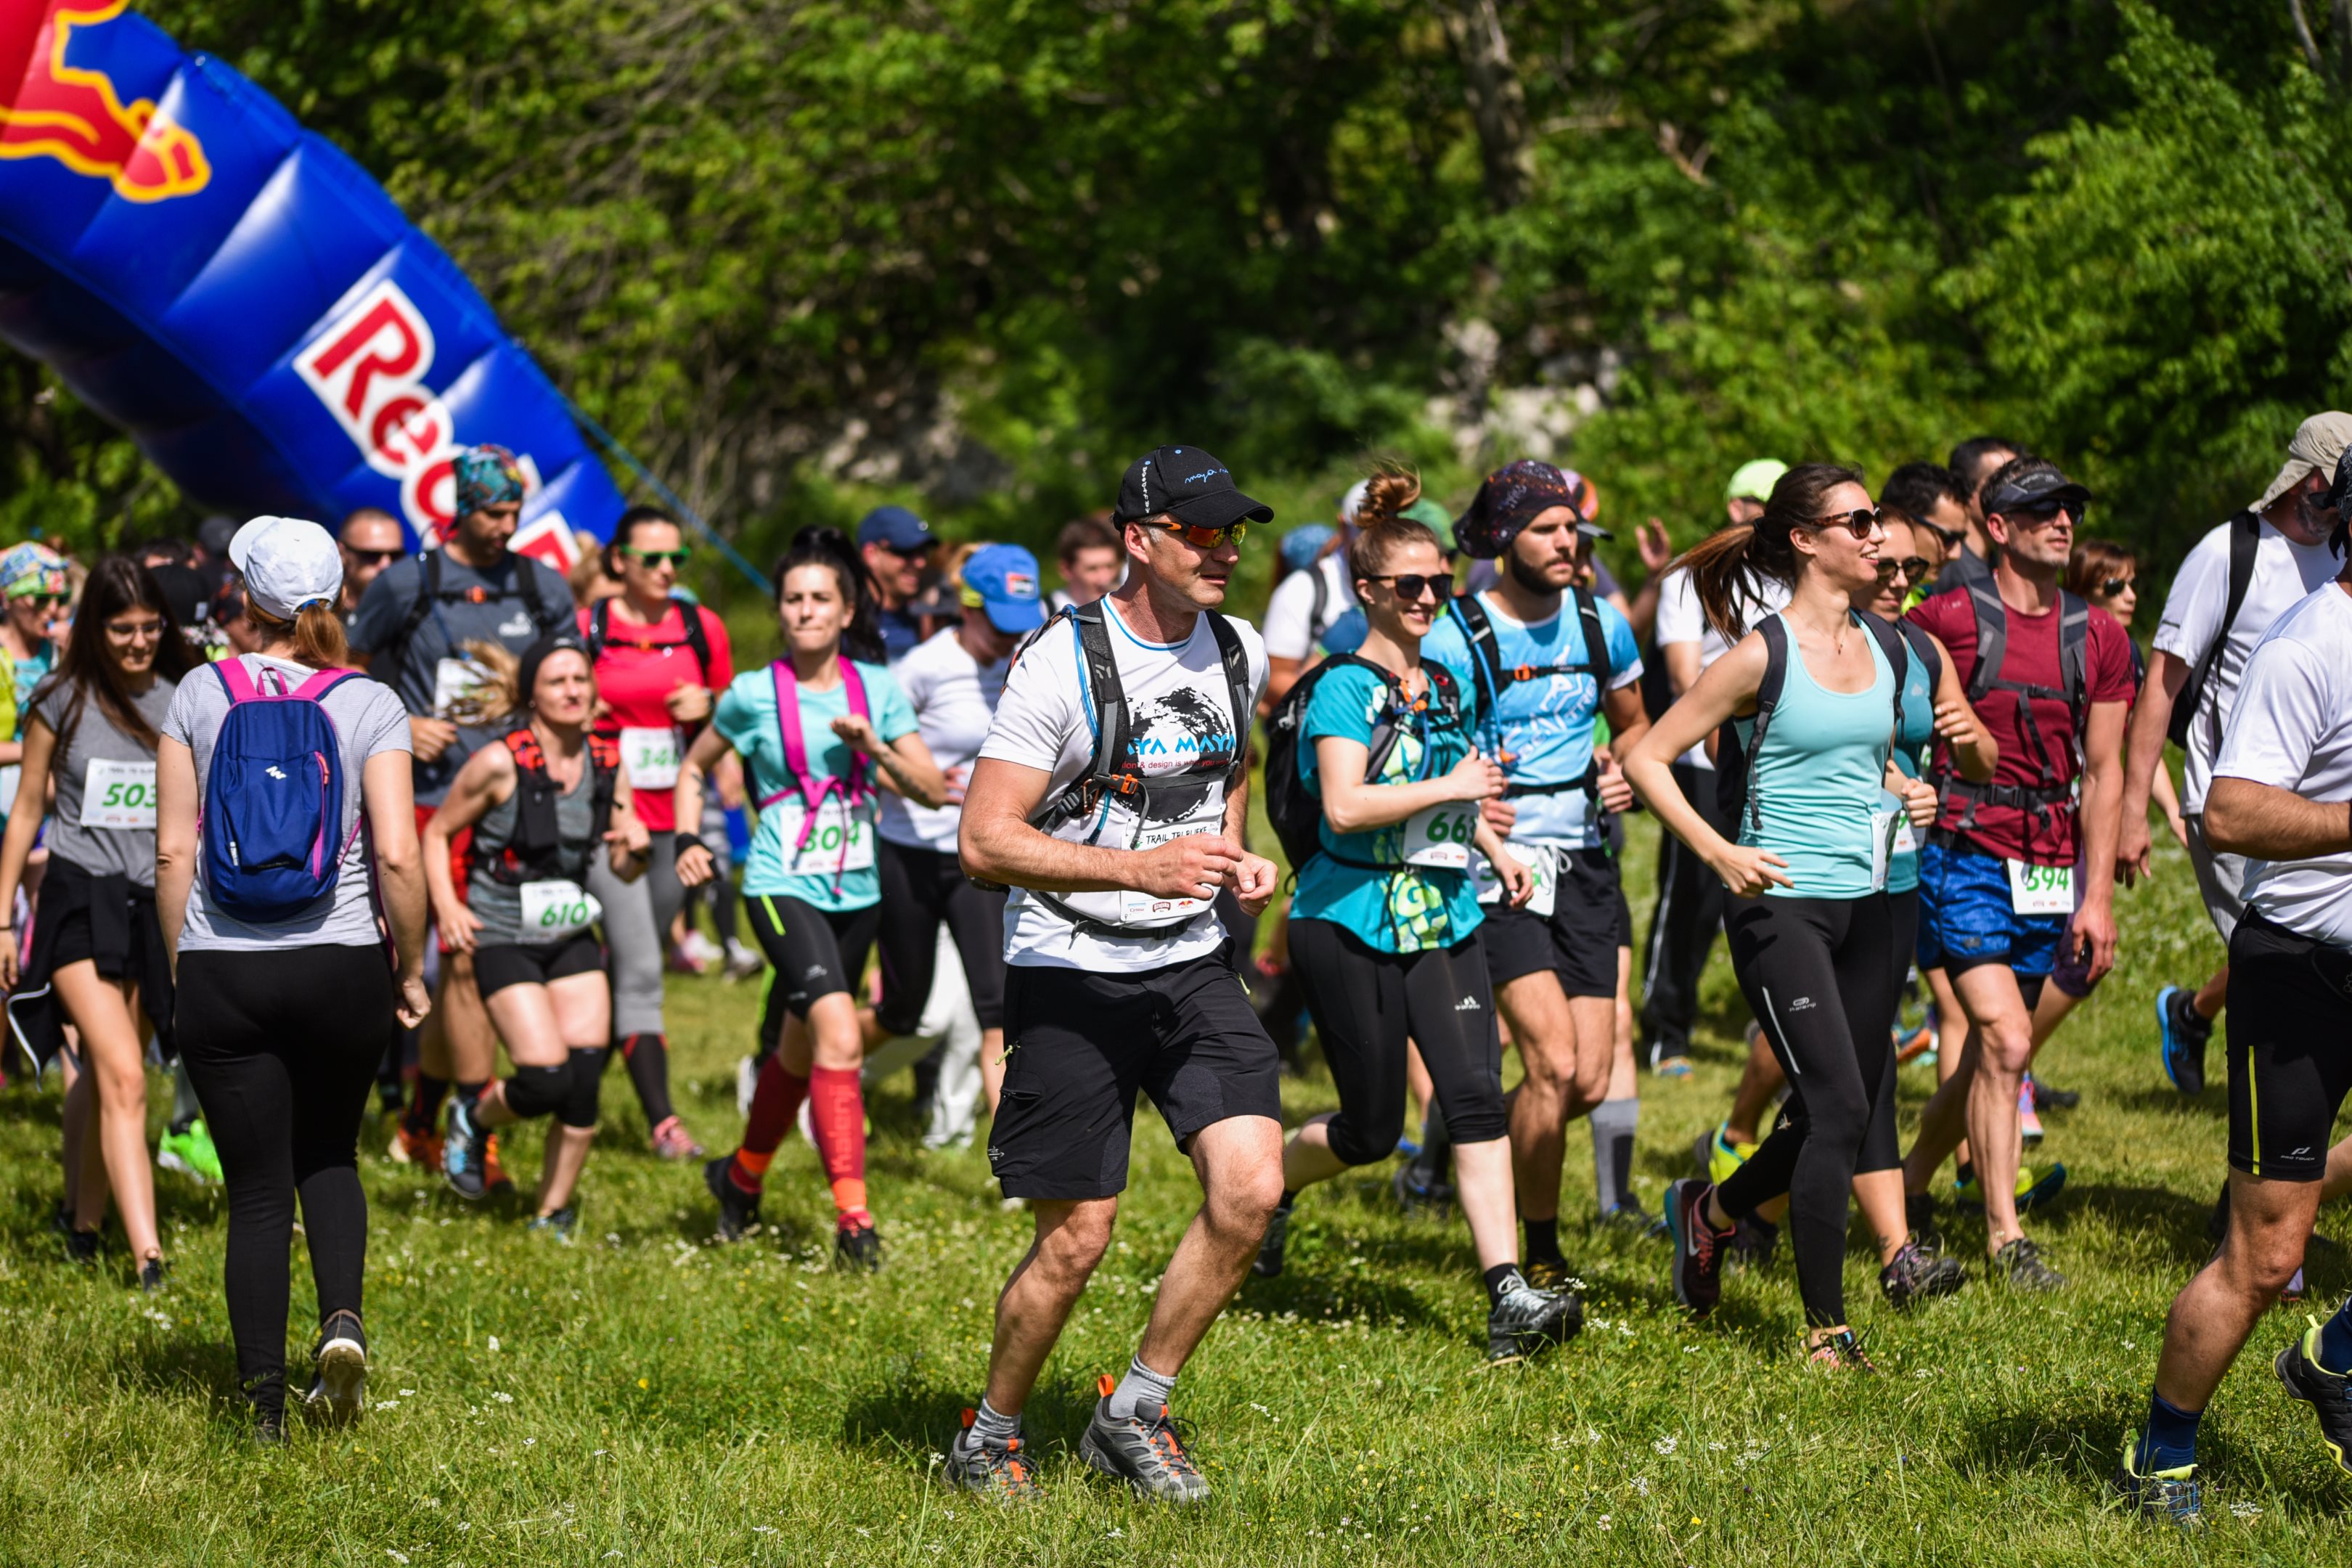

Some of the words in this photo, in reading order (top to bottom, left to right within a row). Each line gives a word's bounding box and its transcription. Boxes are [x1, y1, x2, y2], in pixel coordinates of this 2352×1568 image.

[1148, 761, 1173, 769] design
[1146, 834, 1169, 844] TRAIL
[2026, 865, 2070, 892] 594
[540, 900, 589, 927] 610
